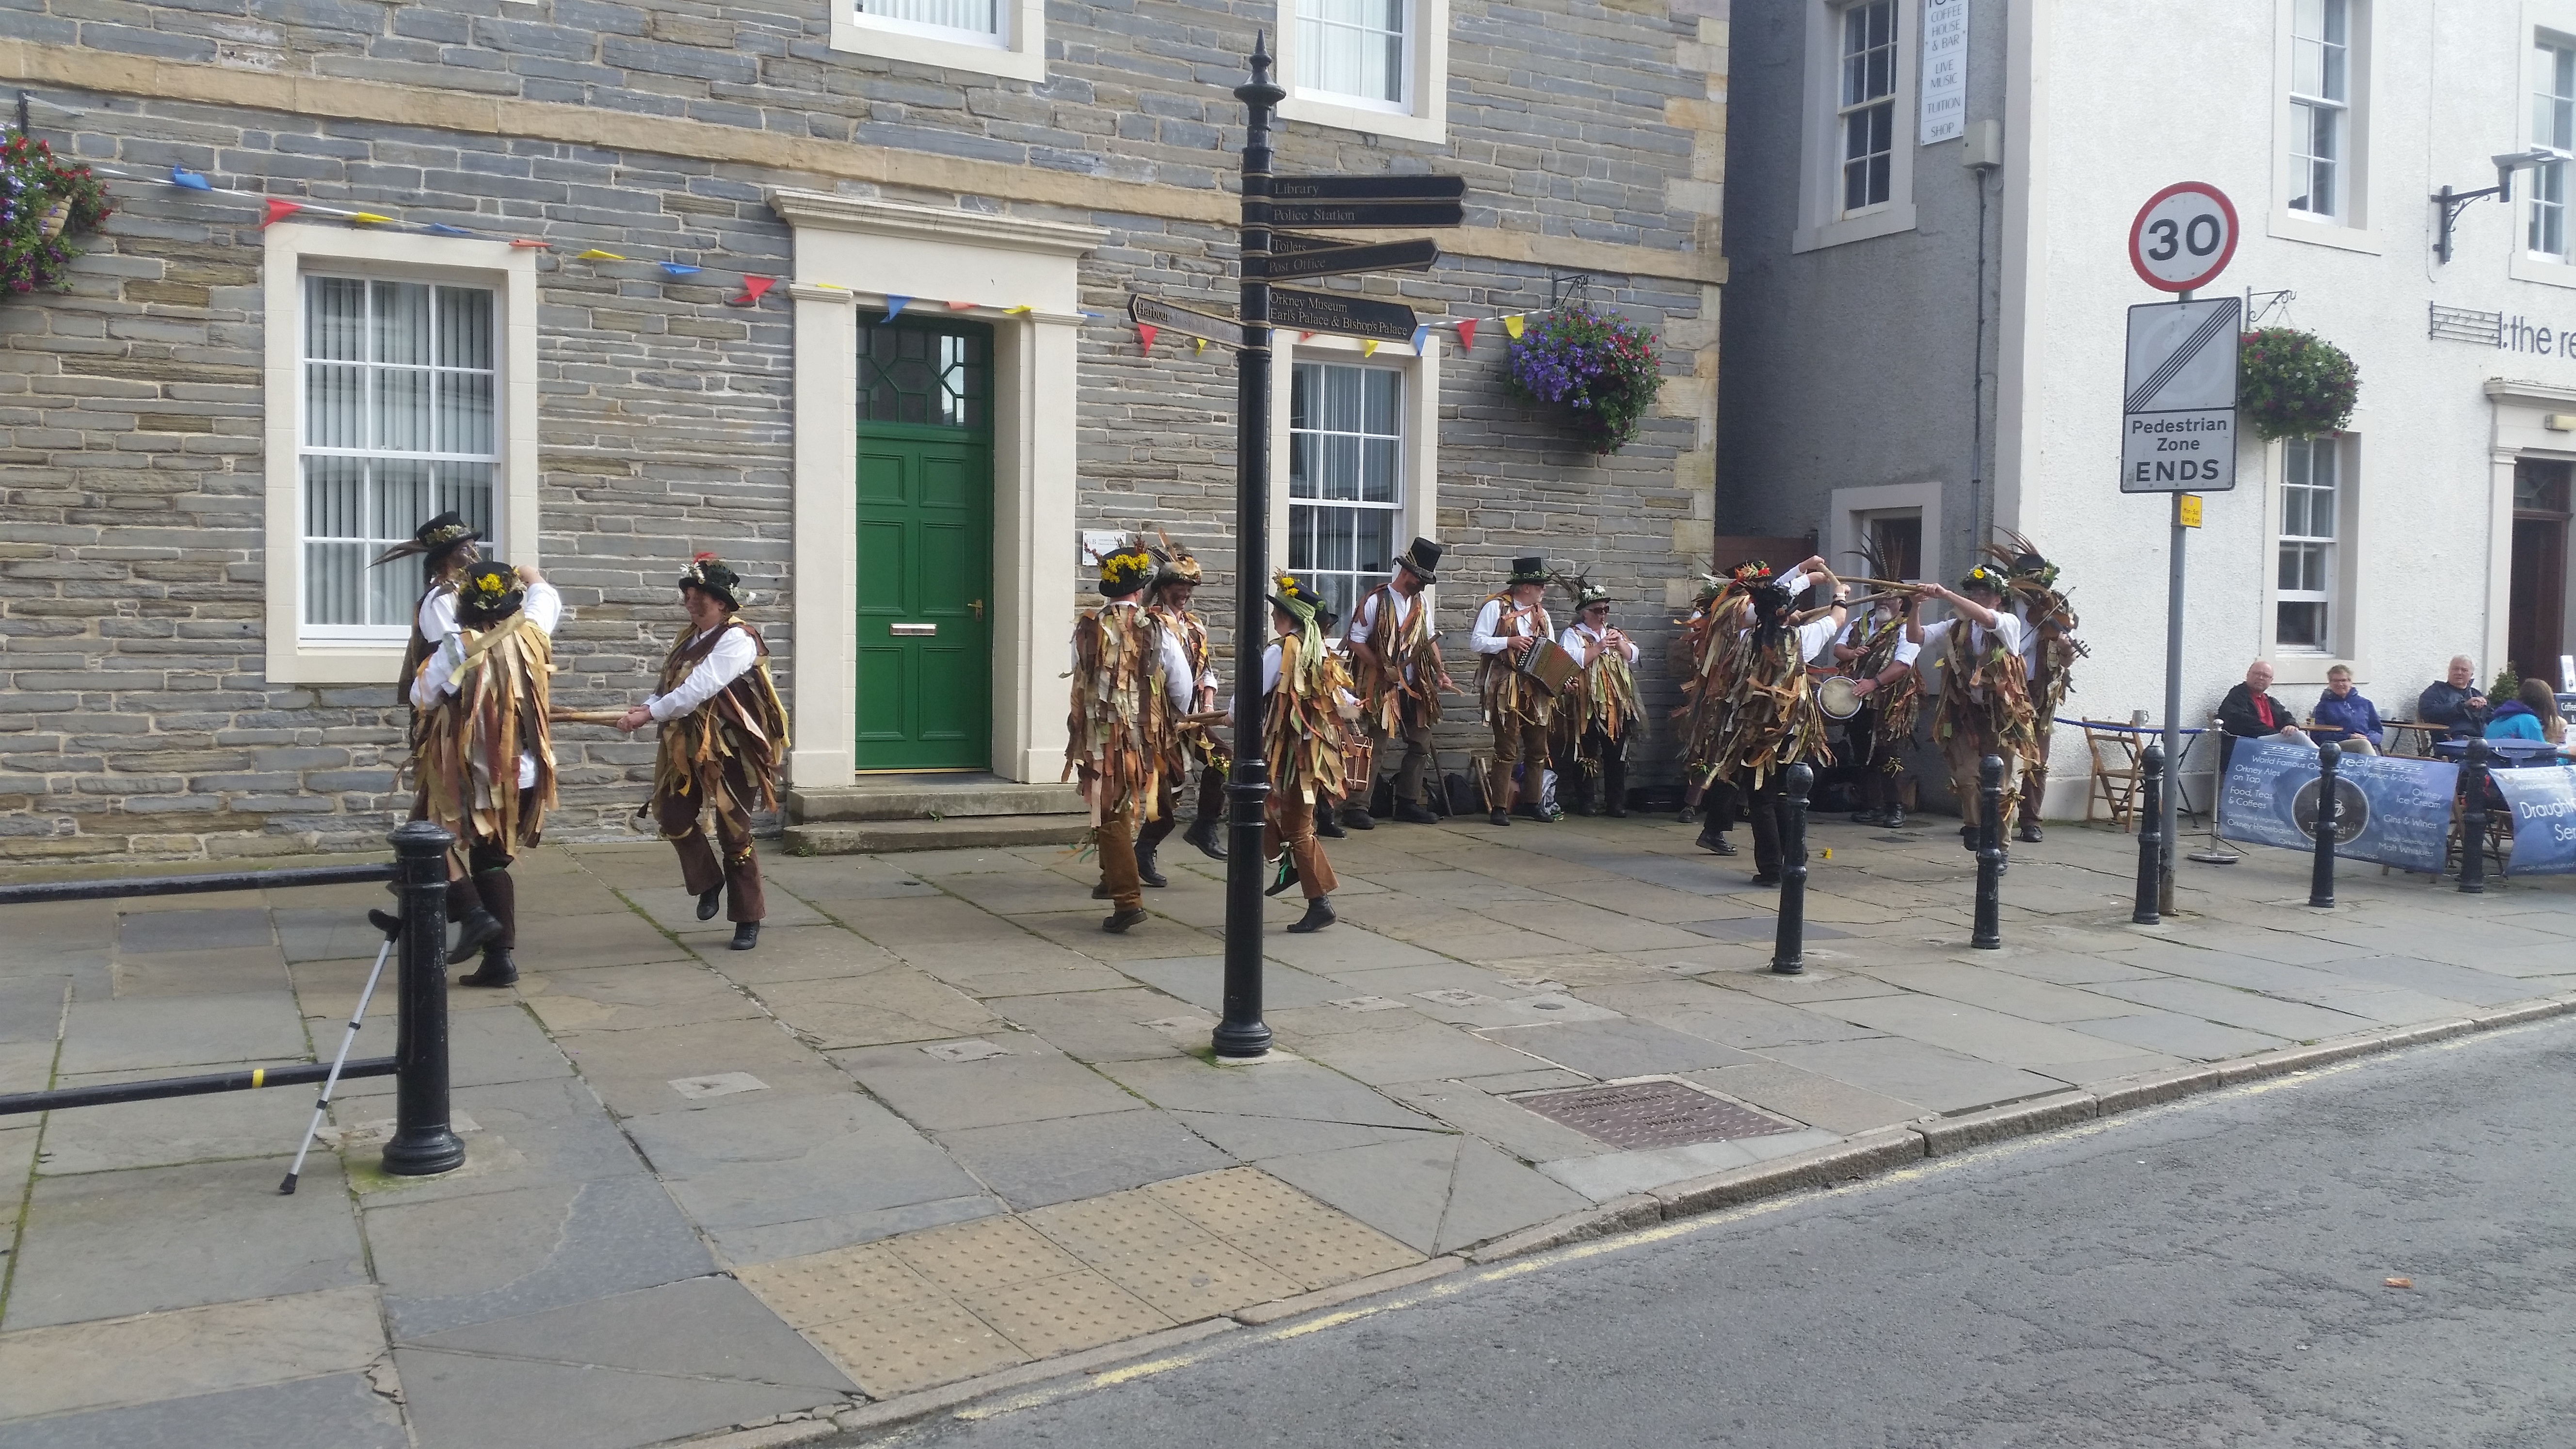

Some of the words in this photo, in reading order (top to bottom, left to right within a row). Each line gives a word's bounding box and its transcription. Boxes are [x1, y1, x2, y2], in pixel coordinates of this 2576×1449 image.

[1932, 4, 1962, 22] COFFEE
[1932, 19, 1960, 37] HOUSE
[1932, 40, 1938, 51] &
[1942, 34, 1959, 48] BAR
[1936, 59, 1954, 74] LIVE
[1931, 73, 1958, 89] MUSIC
[1927, 97, 1961, 114] TUITION
[1931, 122, 1954, 137] SHOP
[1274, 183, 1319, 197] Library
[1273, 209, 1308, 221] Police
[1313, 209, 1355, 221] Station
[1272, 239, 1306, 252] Toilets
[2148, 214, 2221, 262] 30
[1269, 261, 1289, 273] Post
[1294, 258, 1325, 270] Office
[1270, 292, 1304, 310] Orkney
[1308, 297, 1348, 313] Museum
[1137, 302, 1170, 322] Harbour
[1270, 308, 1295, 322] Earl's
[1299, 312, 1329, 326] Palace
[1331, 316, 1340, 327] &
[1343, 317, 1377, 334] Bishop's
[1379, 322, 1407, 336] Palace
[2132, 418, 2226, 434] Pedestrian
[2157, 437, 2200, 451] Zone
[2136, 459, 2219, 482] ENDS
[2236, 764, 2262, 774] Orkney
[2264, 768, 2280, 776] Ales
[2252, 755, 2275, 764] World
[2276, 758, 2305, 768] Famous
[2363, 770, 2388, 779] Venue
[2399, 775, 2428, 785] School
[2247, 774, 2260, 784] Tap
[2230, 786, 2252, 797] Food,
[2255, 789, 2273, 799] Teas
[2412, 789, 2443, 801] Orkney
[2236, 798, 2266, 808] Coffees
[2397, 795, 2410, 804] Ice
[2413, 798, 2440, 808] Cream
[2228, 819, 2252, 829] Orkney
[2254, 823, 2294, 835] Homebakes
[2383, 814, 2401, 824] Gins
[2412, 818, 2437, 829] Wines
[2278, 838, 2305, 848] Orkney
[2357, 850, 2379, 859] Shop
[2378, 842, 2397, 851] Malt
[2399, 845, 2433, 856] Whiskies
